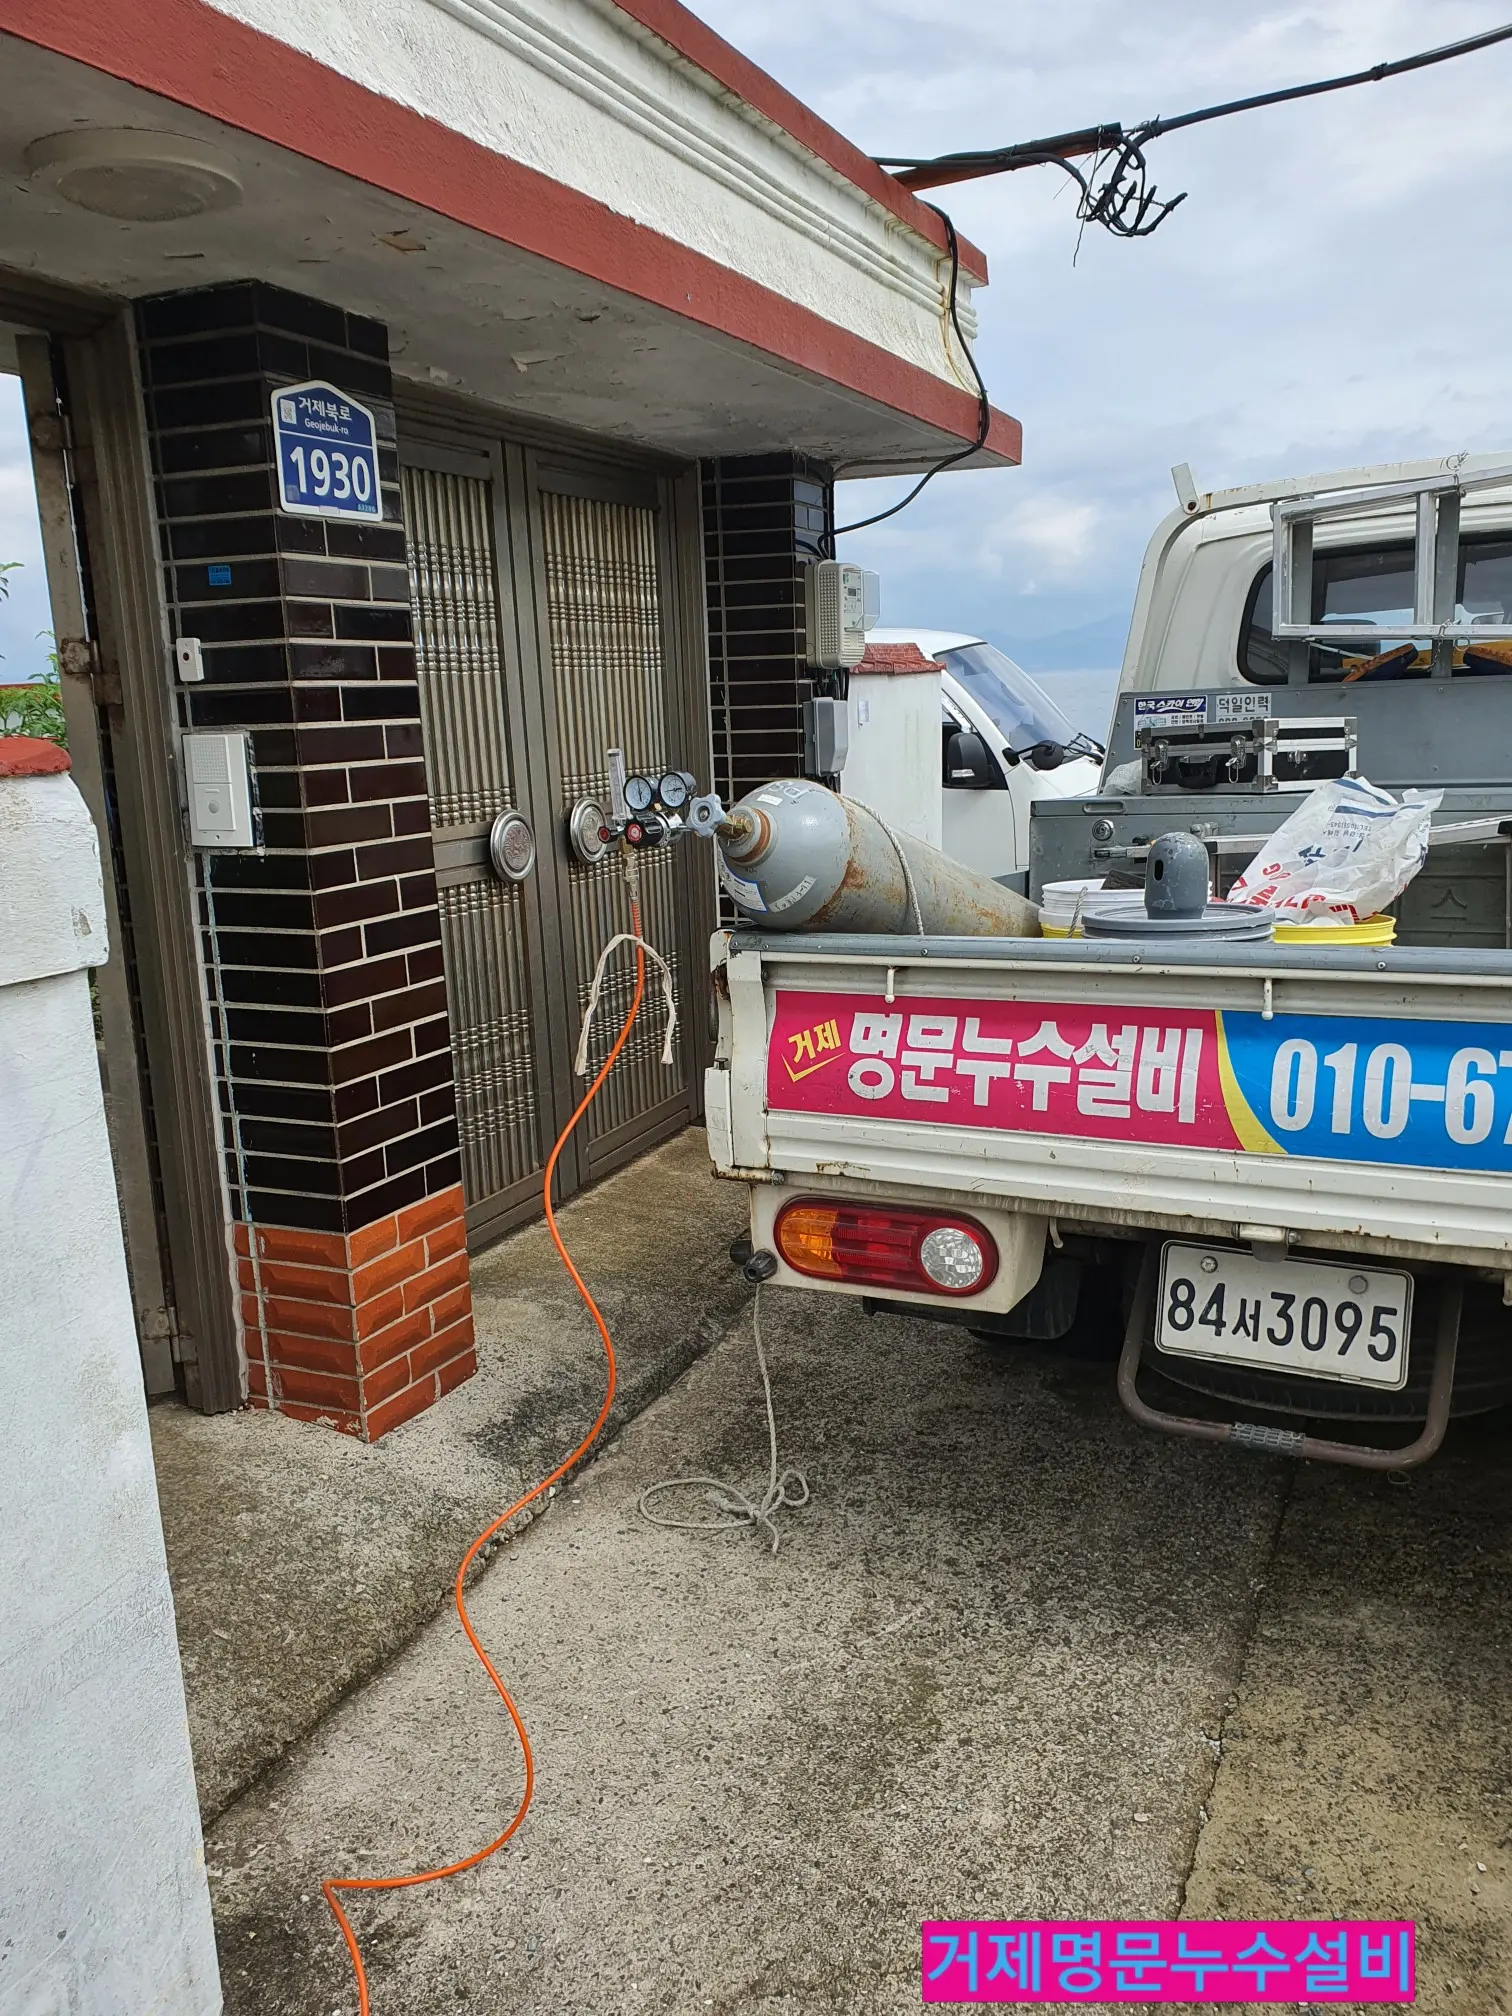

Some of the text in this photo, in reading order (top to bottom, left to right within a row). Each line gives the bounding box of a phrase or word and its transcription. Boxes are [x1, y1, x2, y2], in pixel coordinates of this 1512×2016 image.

[298, 396, 353, 422] 거제북로
[304, 418, 349, 434] Geojebuk-ro
[290, 446, 371, 502] 1930
[1218, 696, 1269, 714] 덕일인력
[787, 1012, 1512, 1146] 거제 명문누수설비 010-6
[1167, 1277, 1398, 1362] 84서3095
